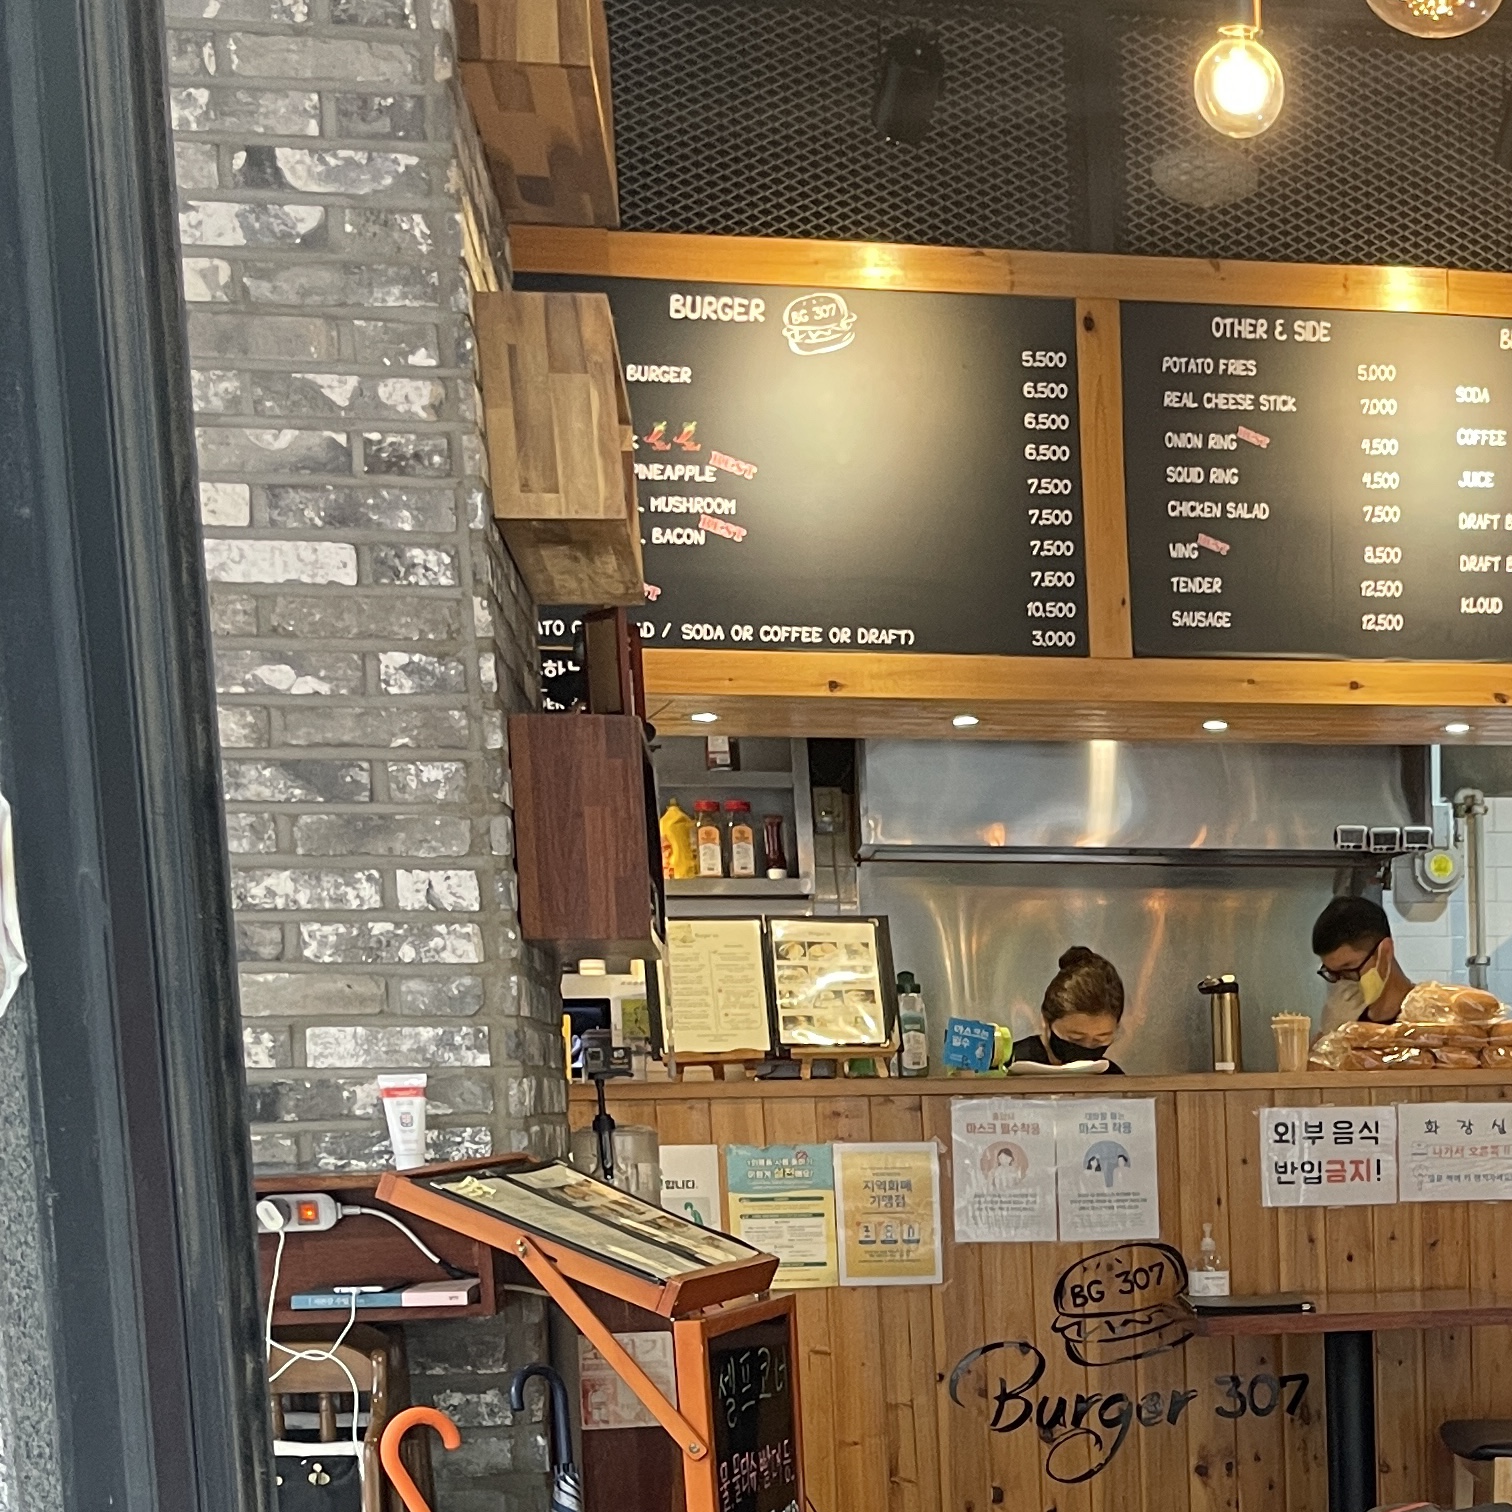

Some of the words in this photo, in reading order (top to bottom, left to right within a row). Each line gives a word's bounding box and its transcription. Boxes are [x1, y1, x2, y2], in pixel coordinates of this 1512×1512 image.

[669, 294, 766, 322] BURGER
[791, 308, 809, 325] BG
[812, 302, 838, 321] 307
[1211, 317, 1268, 340] OTHER
[1294, 320, 1332, 342] SIDE
[626, 364, 692, 384] BURGER
[1162, 357, 1214, 374] POTATO
[1219, 359, 1257, 377] FRIES
[1163, 391, 1199, 408] REAL
[1203, 392, 1255, 410] CHEESE
[1259, 394, 1297, 412] STICK
[1455, 385, 1490, 404] SODA
[1164, 432, 1203, 449] ONION
[1208, 433, 1238, 451] RING
[1456, 428, 1507, 446] COFFEE
[1166, 466, 1204, 484] SQUID
[1209, 467, 1239, 485] RING
[1458, 471, 1495, 488] JUICE
[650, 497, 737, 515] MUSHROOM
[1167, 500, 1222, 518] CHICKEN
[1226, 502, 1270, 520] SALAD
[1458, 512, 1501, 530] DRAFT
[651, 527, 706, 545] BACON
[1169, 543, 1199, 559] WING
[1459, 555, 1501, 573] DRAFT
[1170, 577, 1223, 594] TENDER
[1460, 597, 1504, 614] KLOUD
[1172, 611, 1232, 629] SAUSAGE
[681, 623, 725, 640] SODA
[731, 625, 754, 642] OR
[760, 625, 822, 643] COFFEE
[829, 627, 852, 644] OR
[857, 627, 915, 645] DRAFT)
[1274, 1157, 1382, 1185] 반입금지!
[1069, 1279, 1105, 1308] BG
[1115, 1261, 1166, 1296] 307
[949, 1341, 1199, 1484] Burger
[1215, 1372, 1310, 1419] 307
